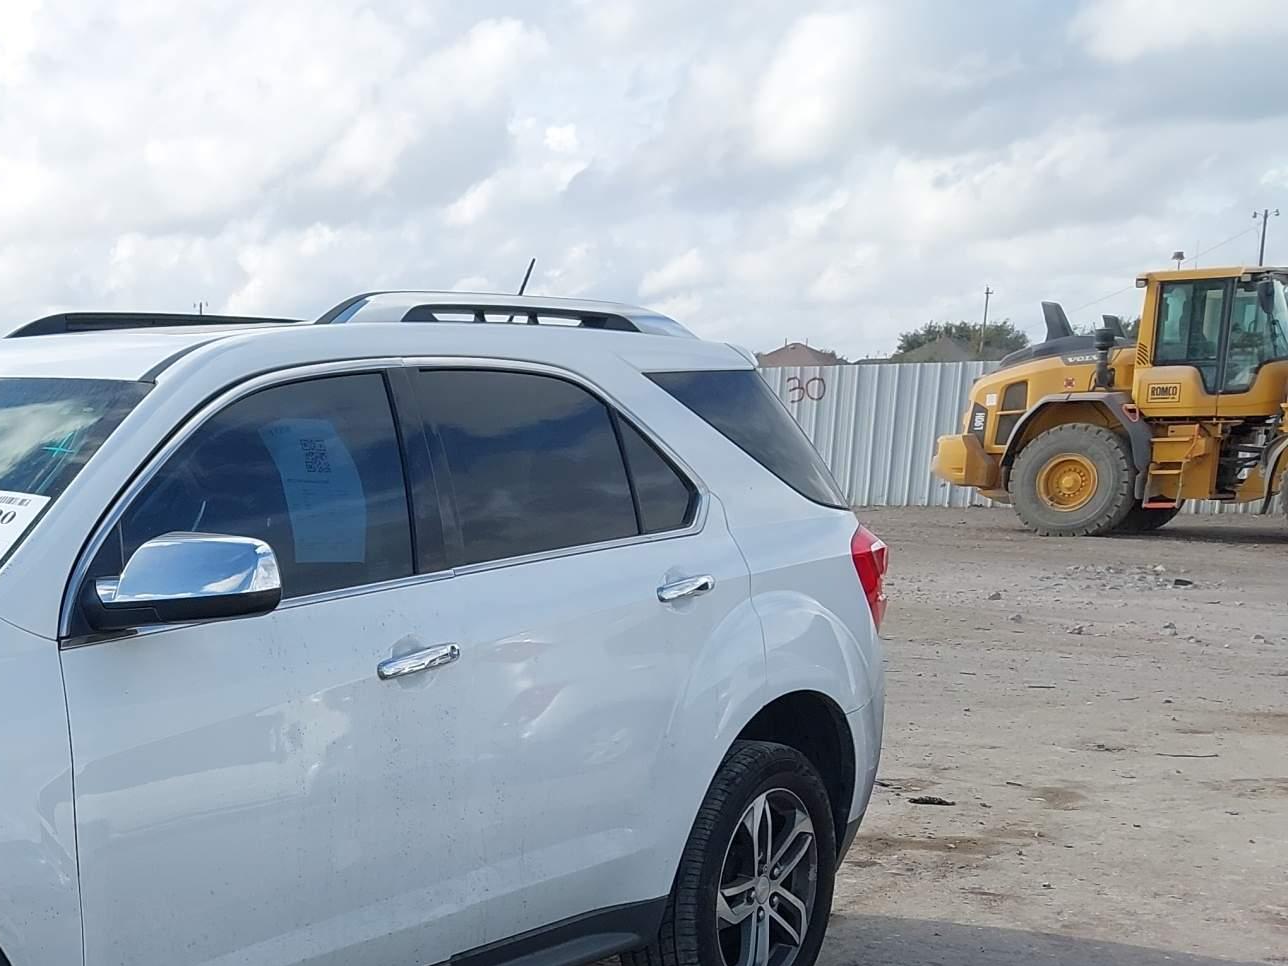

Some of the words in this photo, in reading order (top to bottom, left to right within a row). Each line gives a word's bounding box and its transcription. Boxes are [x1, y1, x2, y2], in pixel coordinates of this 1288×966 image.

[1067, 354, 1098, 363] VOLV
[787, 376, 826, 403] 30
[1150, 386, 1178, 397] ROMCO
[973, 412, 986, 431] L90H
